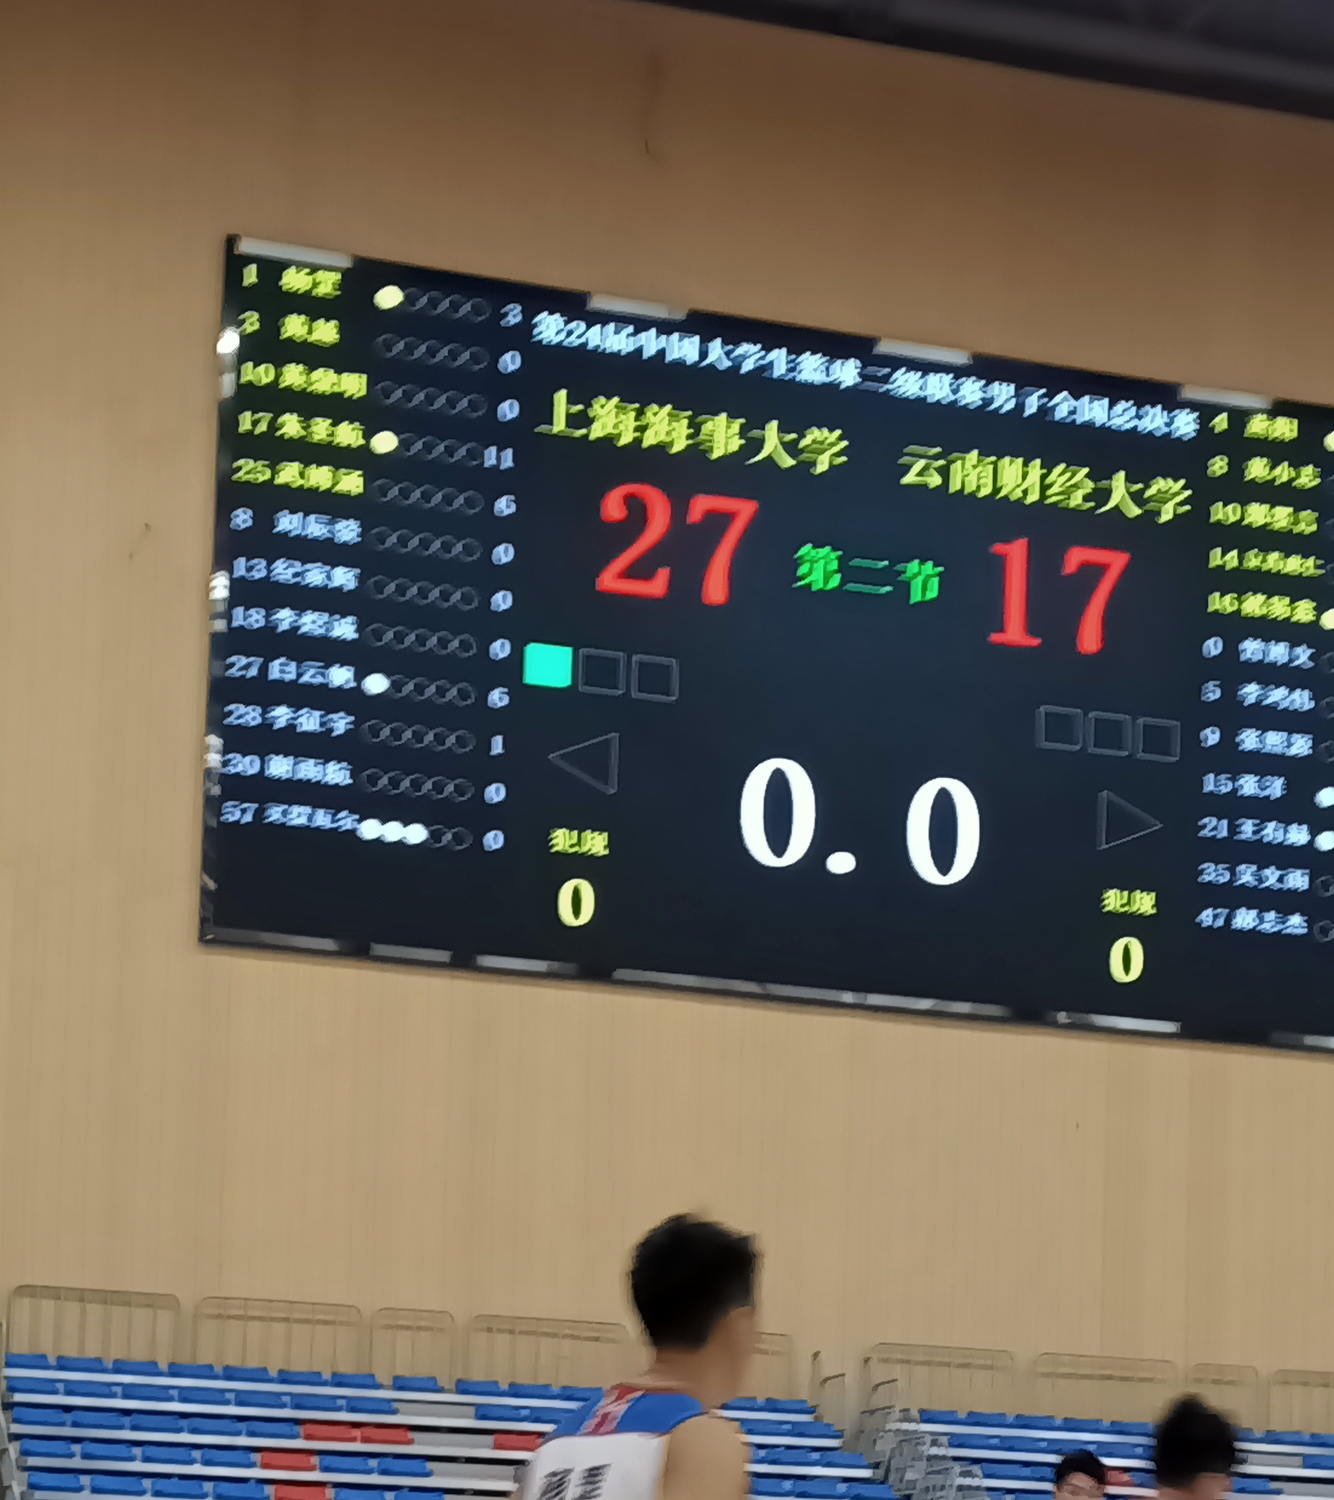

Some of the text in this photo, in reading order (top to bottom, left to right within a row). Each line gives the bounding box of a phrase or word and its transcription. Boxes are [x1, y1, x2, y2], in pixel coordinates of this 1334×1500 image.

[239, 362, 275, 386] 10
[498, 351, 521, 374] 0
[497, 399, 519, 421] 0
[238, 411, 273, 434] 17
[535, 387, 849, 475] 上海海事大学
[484, 446, 514, 470] 11
[1207, 455, 1228, 477] 8
[231, 459, 271, 483] 25
[897, 445, 1192, 523] 云南财经大学
[230, 508, 253, 530] 8
[1210, 502, 1242, 525] 10
[492, 543, 515, 565] 0
[596, 483, 759, 606] 27
[232, 557, 268, 580] 13
[792, 543, 944, 604] 第二节
[490, 590, 513, 612] 0
[989, 538, 1131, 655] 17
[231, 606, 268, 629] 18
[489, 639, 511, 660] 0
[1202, 637, 1223, 658] 0
[225, 655, 264, 678] 27
[1201, 681, 1221, 702] 5
[223, 704, 262, 727] 28
[490, 735, 504, 755] 1
[484, 783, 506, 804] 0
[1203, 773, 1234, 795] 15
[220, 801, 259, 824] 57
[740, 758, 980, 885] 0.0
[1198, 817, 1228, 839] 21
[483, 830, 504, 851] 0
[1197, 863, 1230, 884] 35
[558, 879, 595, 926] 0
[1195, 908, 1230, 928] 47
[1109, 937, 1144, 983] 0
